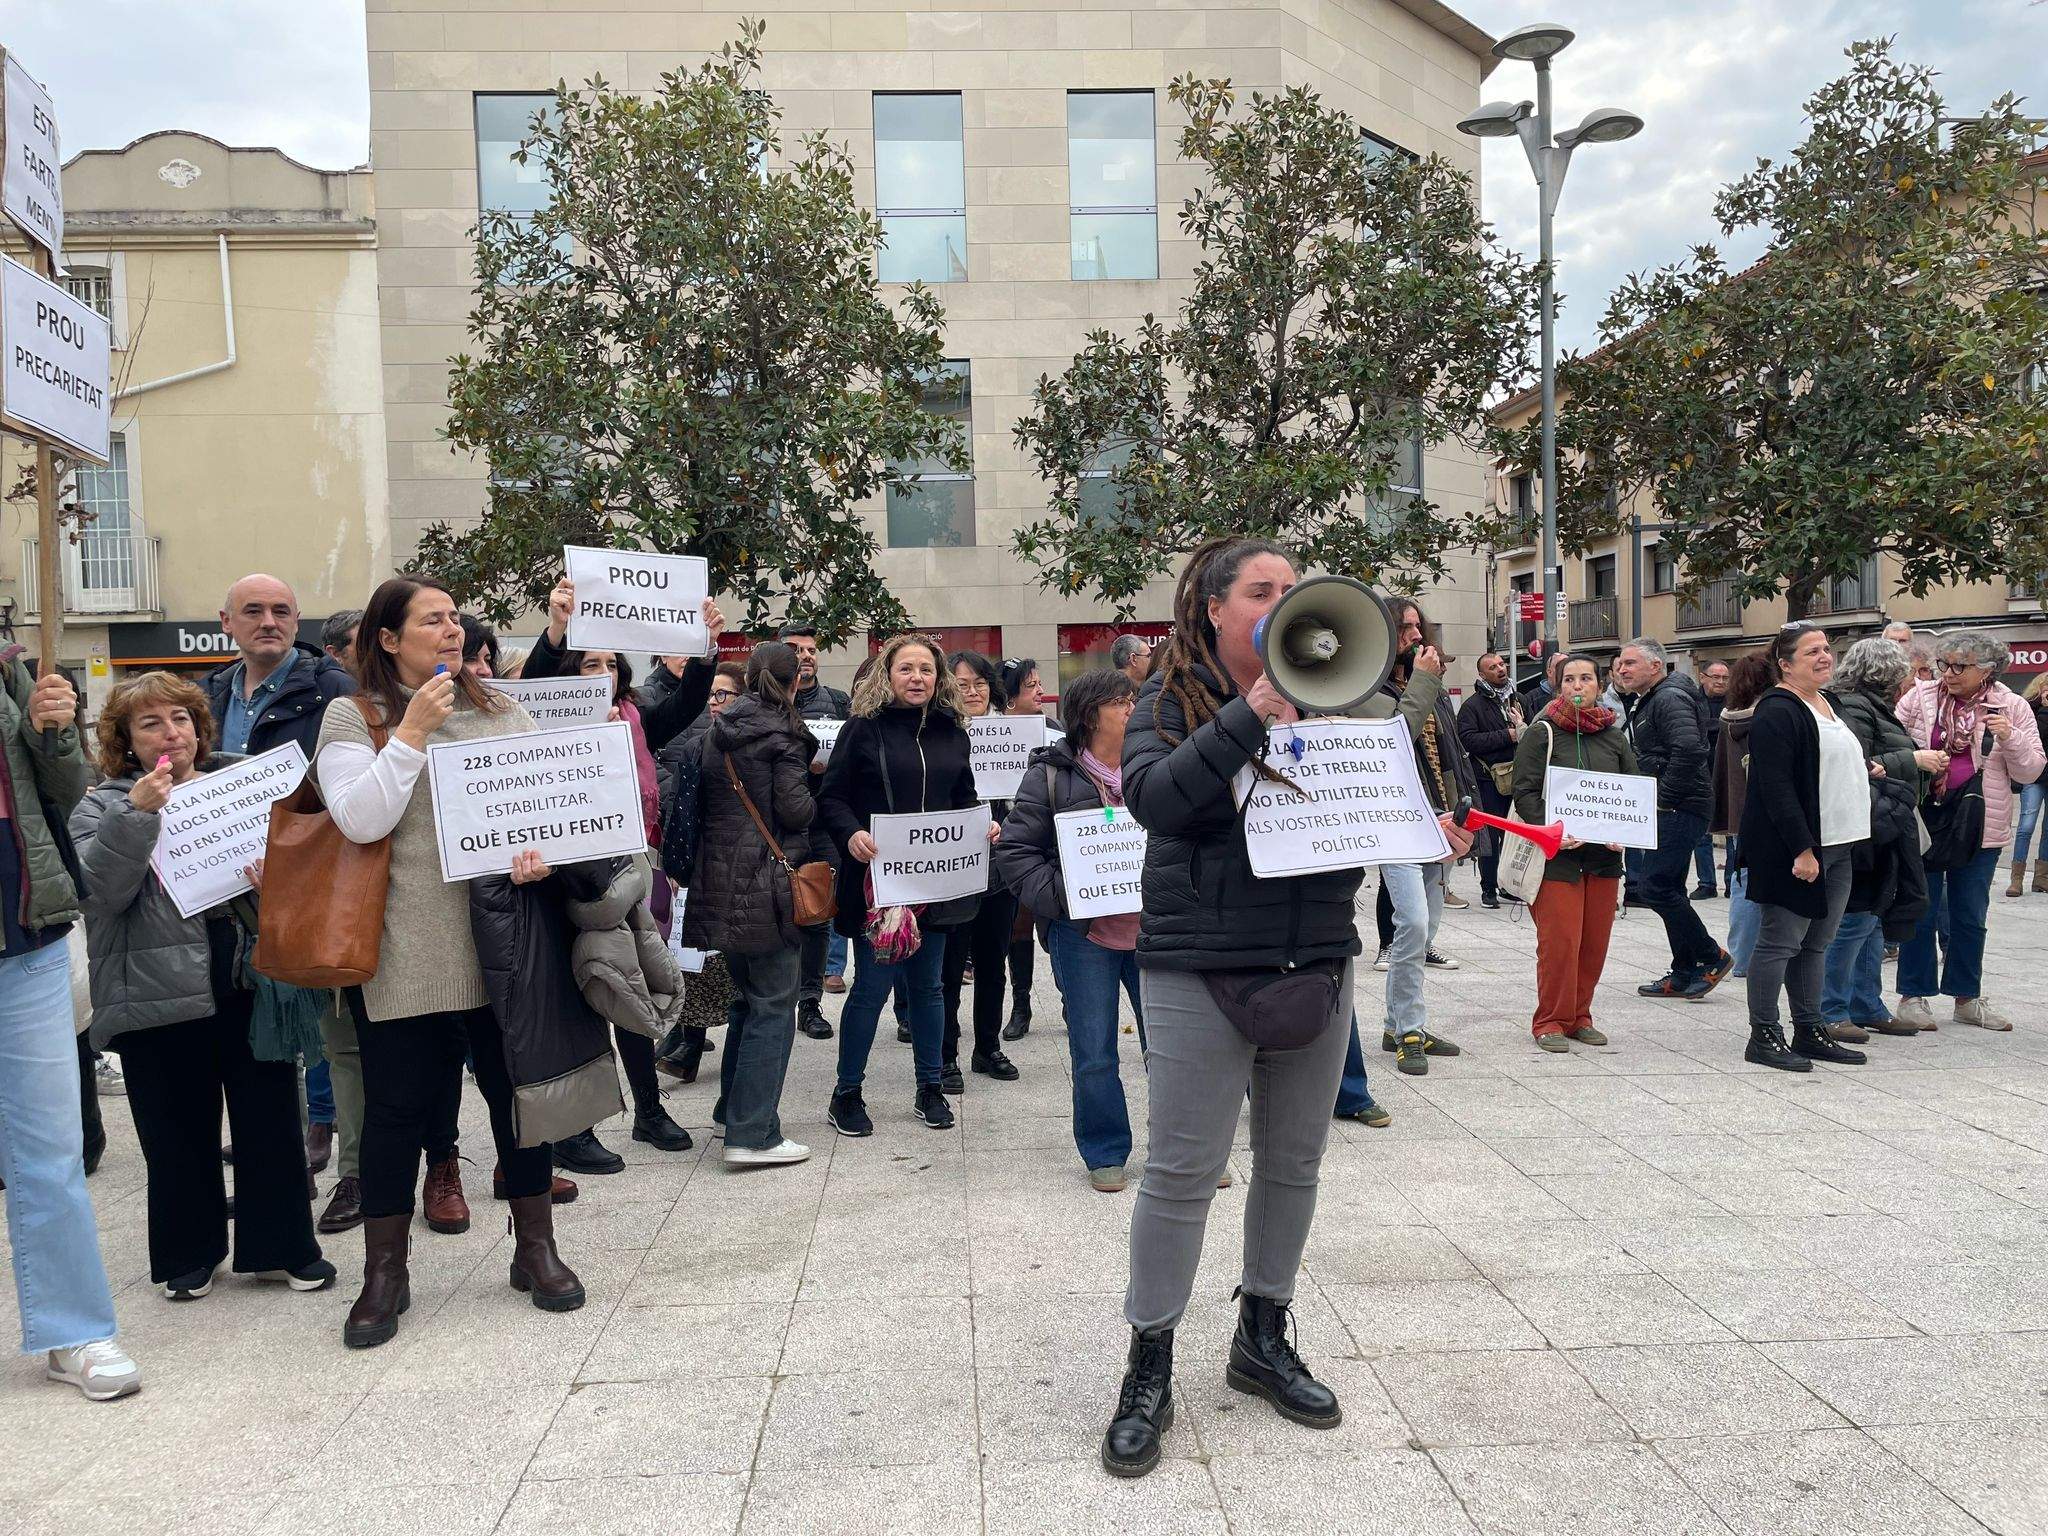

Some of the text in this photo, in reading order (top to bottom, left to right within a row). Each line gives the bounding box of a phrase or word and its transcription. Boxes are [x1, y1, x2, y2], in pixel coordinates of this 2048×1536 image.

[33, 104, 58, 150] EST
[26, 195, 57, 240] MENT
[37, 301, 84, 350] PROU
[16, 345, 103, 410] PRECARIETAT
[609, 566, 668, 589] PROU
[581, 601, 697, 624] PRECARIETAT
[518, 692, 530, 702] LA
[534, 687, 592, 702] VALORACIÓ
[595, 688, 607, 698] DE
[529, 706, 594, 719] DE TREBALL?
[968, 726, 1012, 737] ON ÉS LA
[464, 741, 601, 771] 228 COMPANYES I
[971, 742, 1026, 755] ORACIÓ DE
[1275, 742, 1295, 755] LA
[1304, 736, 1374, 752] ALORACIÓ
[1380, 737, 1396, 750] DE
[975, 761, 1027, 772] DE TREBAL
[1300, 764, 1320, 778] DE
[1322, 761, 1387, 775] TREBALL?
[182, 796, 201, 808] LA
[201, 766, 275, 801] VALORACIÓ
[276, 759, 294, 774] DE
[466, 764, 605, 796] COMPANYS SENSE
[1580, 779, 1624, 791] ON ÉS LA
[486, 792, 593, 818] ESTABILITZAR.
[1248, 785, 1407, 809] NO ENS UTILITZEU PER
[1566, 793, 1638, 808] VALORACIÓ DE
[167, 782, 290, 836] LLOCS DE TREBALL?
[1555, 806, 1649, 824] LLOCS DE TREBALL?
[460, 813, 625, 852] QUÈ ESTEU FENT?
[1076, 825, 1098, 837] 228
[1247, 809, 1424, 835] ALS VOSTRES INTERESSOS
[169, 844, 192, 860] NO
[193, 832, 221, 850] ENS
[909, 825, 963, 845] PROU
[1311, 834, 1381, 853] POLÍTICS!
[1080, 840, 1142, 856] COMPANYS
[173, 864, 198, 882] ALS
[197, 841, 257, 870] VOSTRES
[883, 852, 981, 876] PRECARIETAT
[1112, 881, 1143, 895] ESTE
